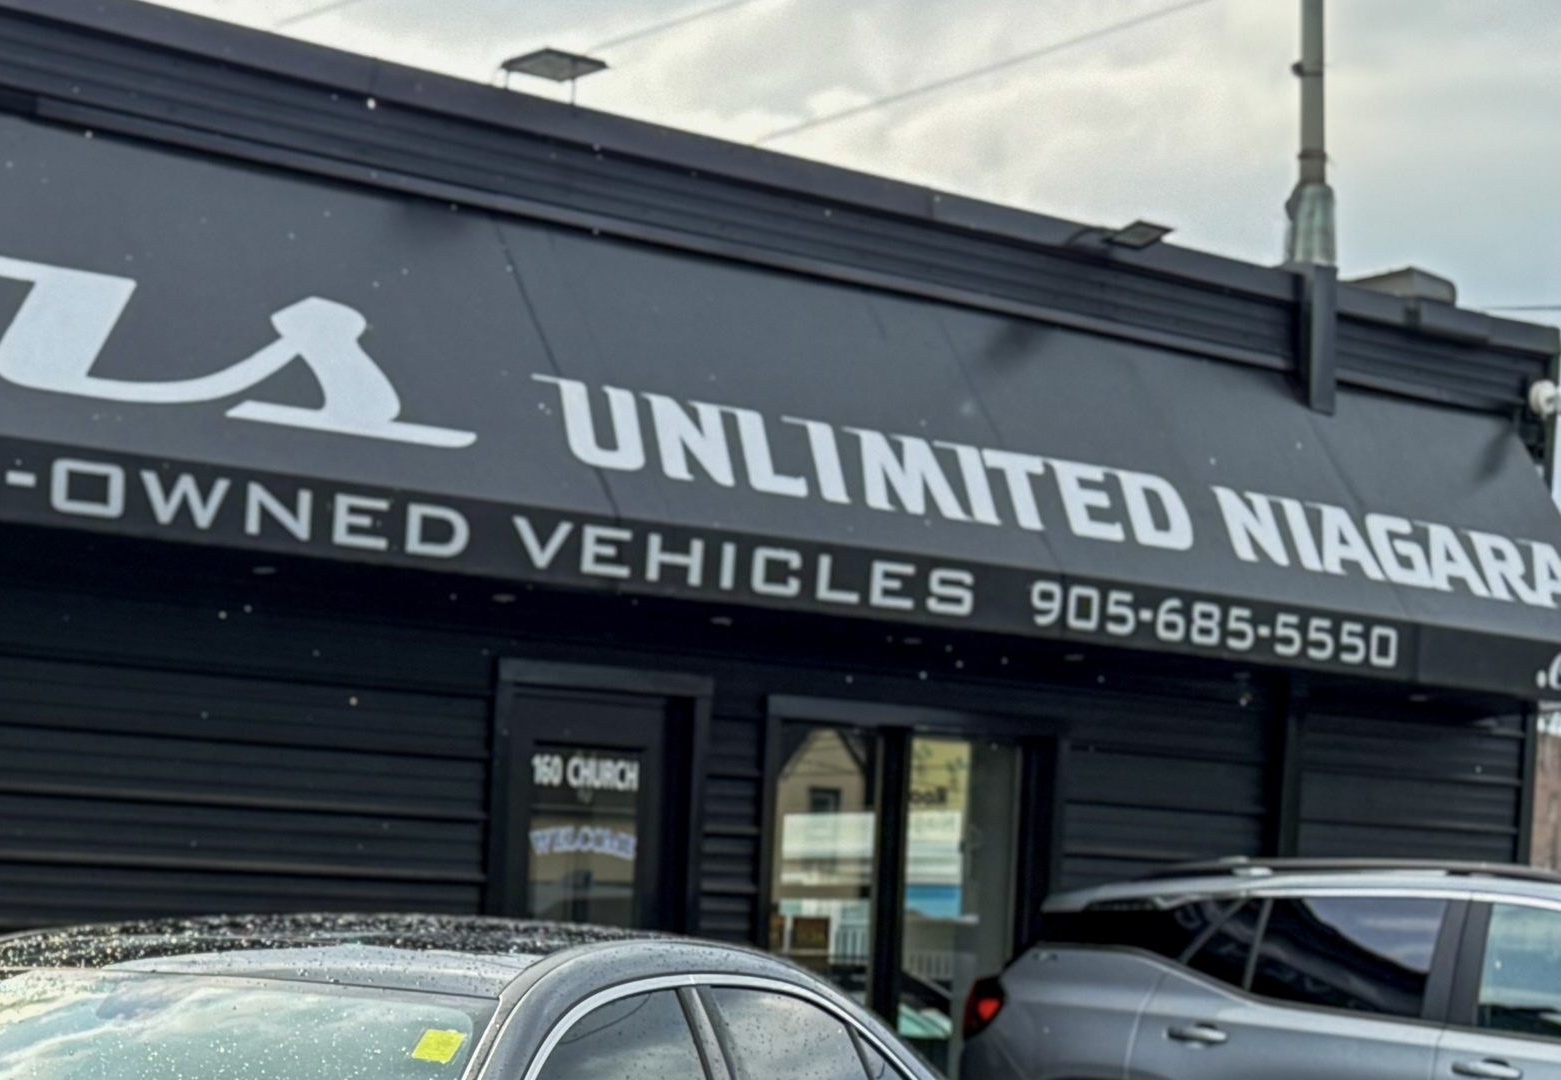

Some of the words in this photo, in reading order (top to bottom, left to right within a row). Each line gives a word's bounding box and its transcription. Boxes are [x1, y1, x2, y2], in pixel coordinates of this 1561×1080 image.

[531, 373, 1193, 551] UNLIMITED
[512, 514, 975, 617] VEHICLES
[1029, 581, 1399, 668] 905-685-5550
[531, 754, 564, 787] 160
[566, 756, 639, 791] CHURCH
[528, 824, 637, 861] WELCOME
